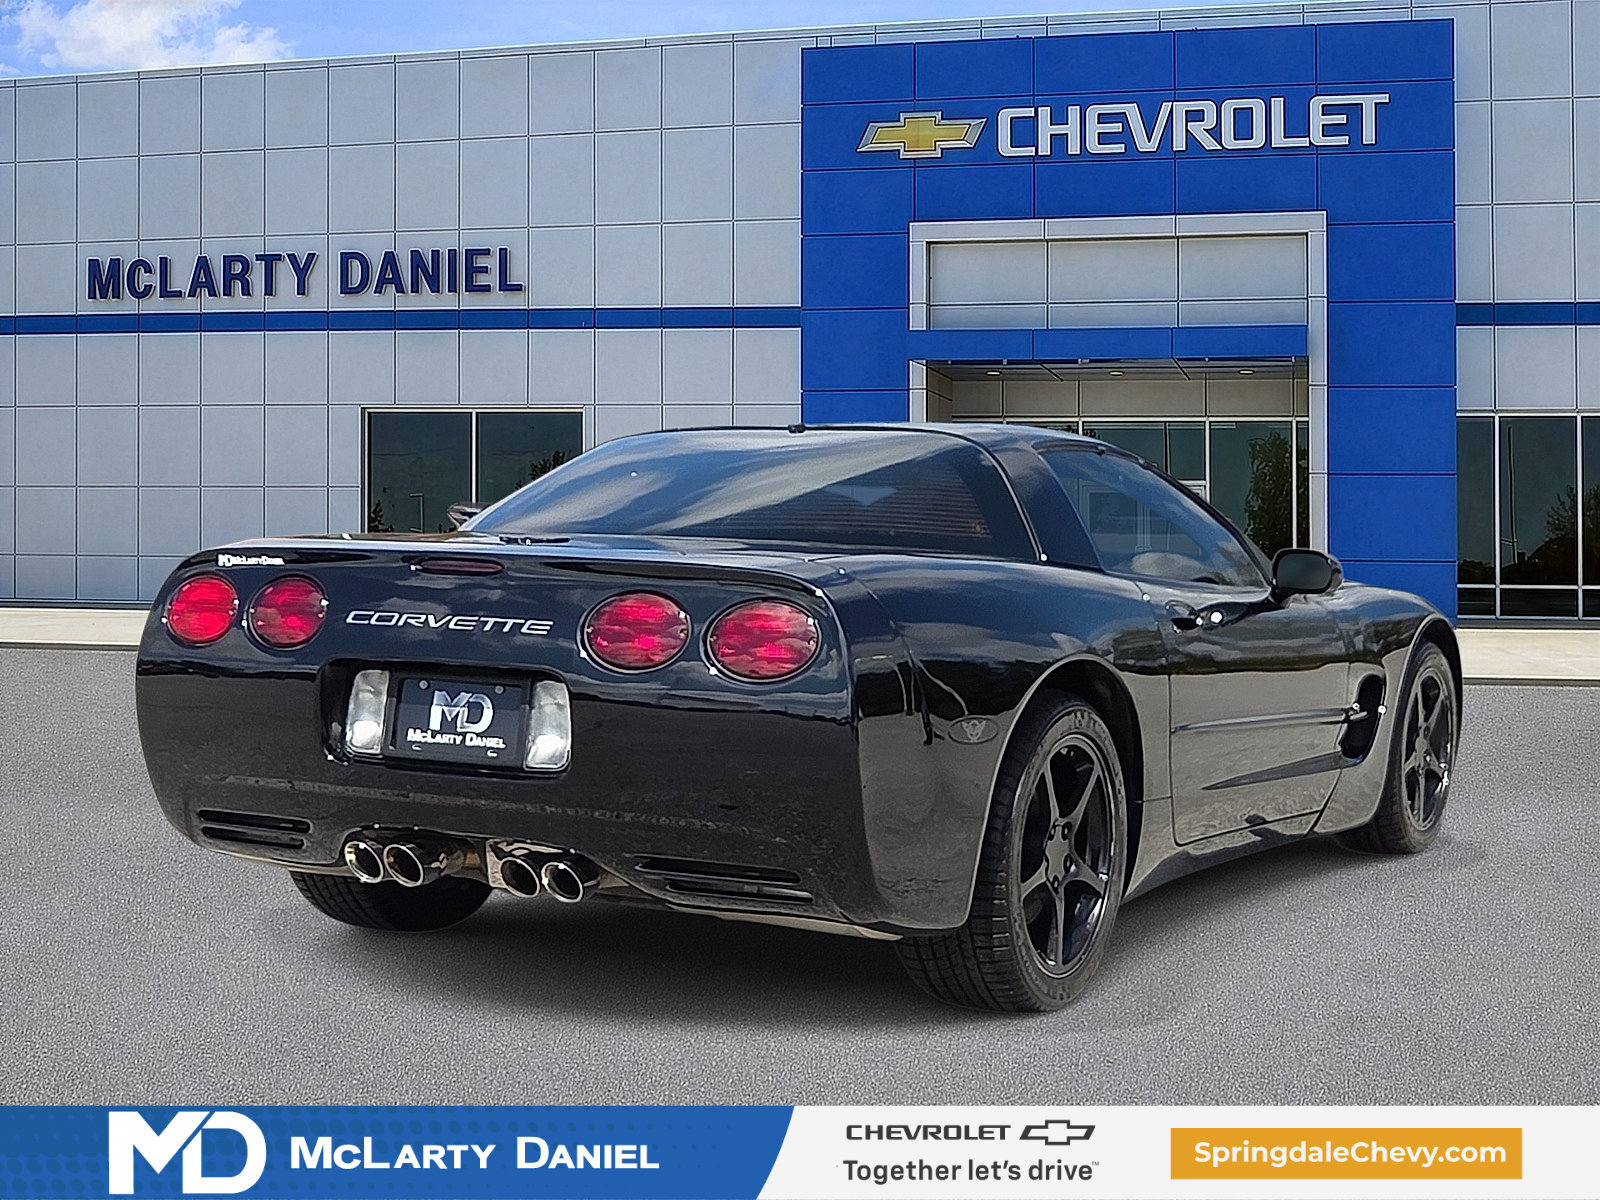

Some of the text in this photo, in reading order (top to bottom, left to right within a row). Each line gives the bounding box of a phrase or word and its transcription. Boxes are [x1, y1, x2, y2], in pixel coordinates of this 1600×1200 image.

[997, 93, 1390, 157] CHEVROLET
[87, 247, 525, 300] MCLARTY DANIEL
[345, 610, 554, 635] CORVETTE
[429, 690, 494, 733] MD
